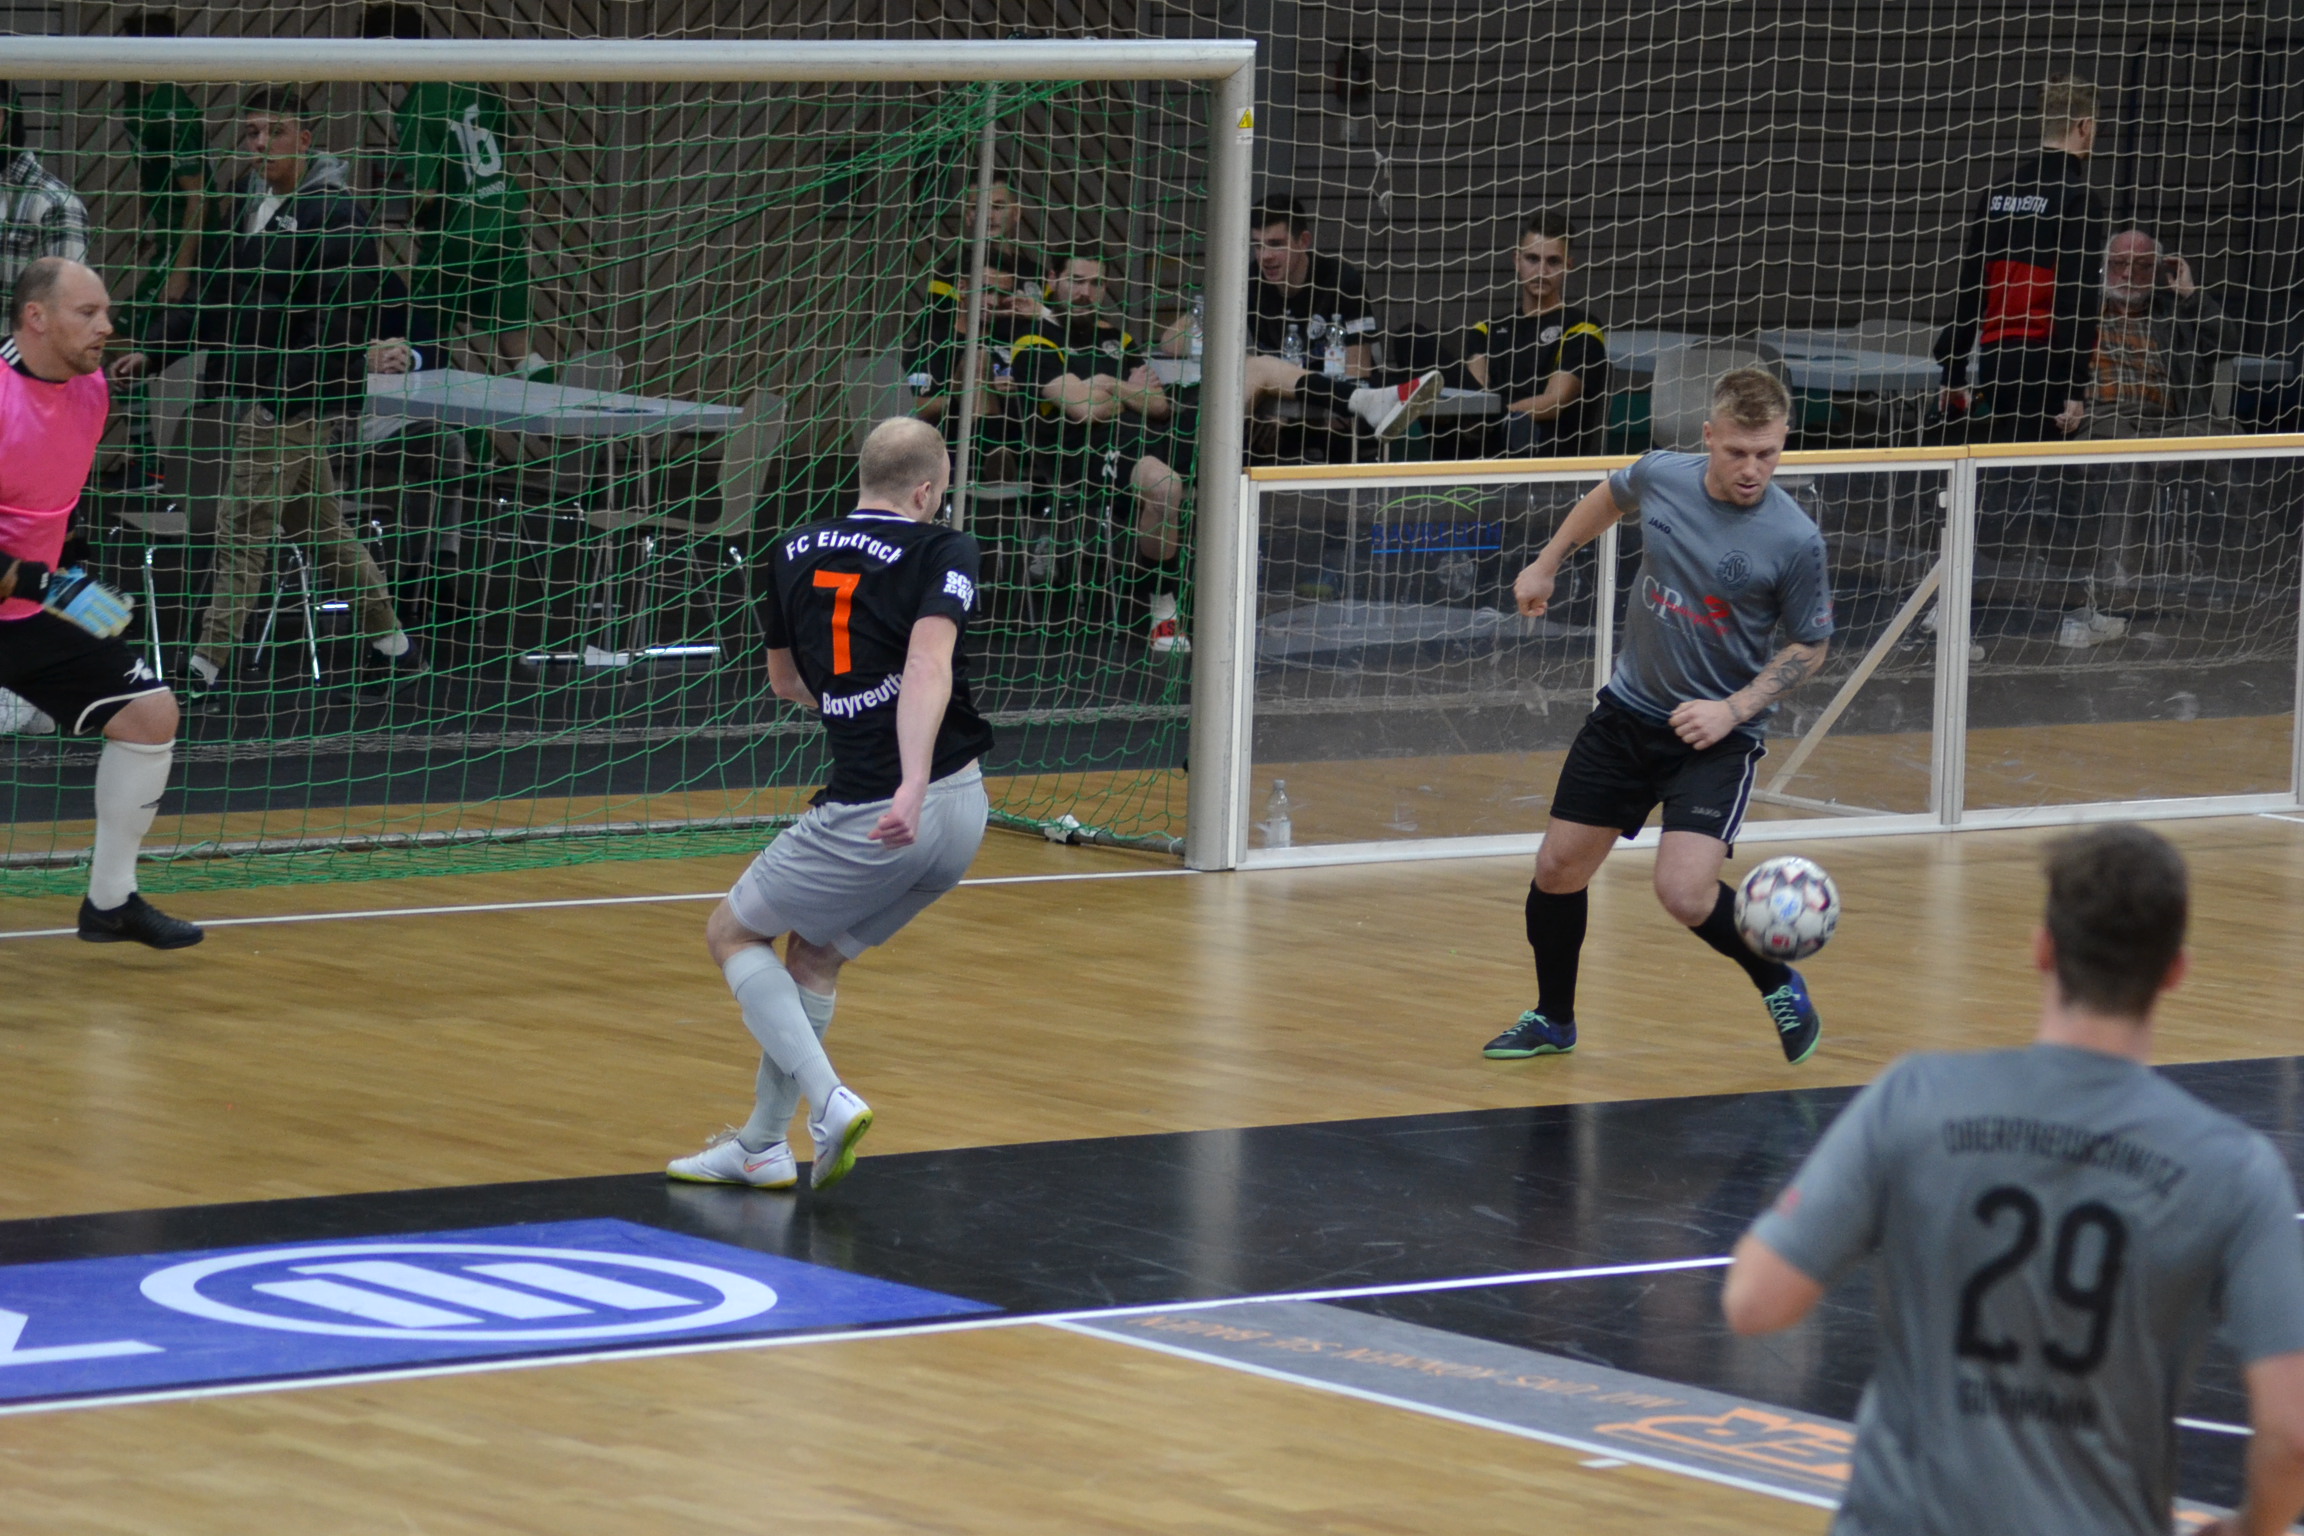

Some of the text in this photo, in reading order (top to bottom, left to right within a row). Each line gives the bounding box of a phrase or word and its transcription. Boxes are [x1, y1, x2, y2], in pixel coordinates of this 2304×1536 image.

[1371, 521, 1501, 546] BAYREUTH
[1648, 517, 1672, 534] JAKO
[786, 535, 810, 561] FC
[813, 569, 862, 675] 7
[822, 673, 903, 718] Bayreuth
[1957, 1186, 2127, 1376] 29
